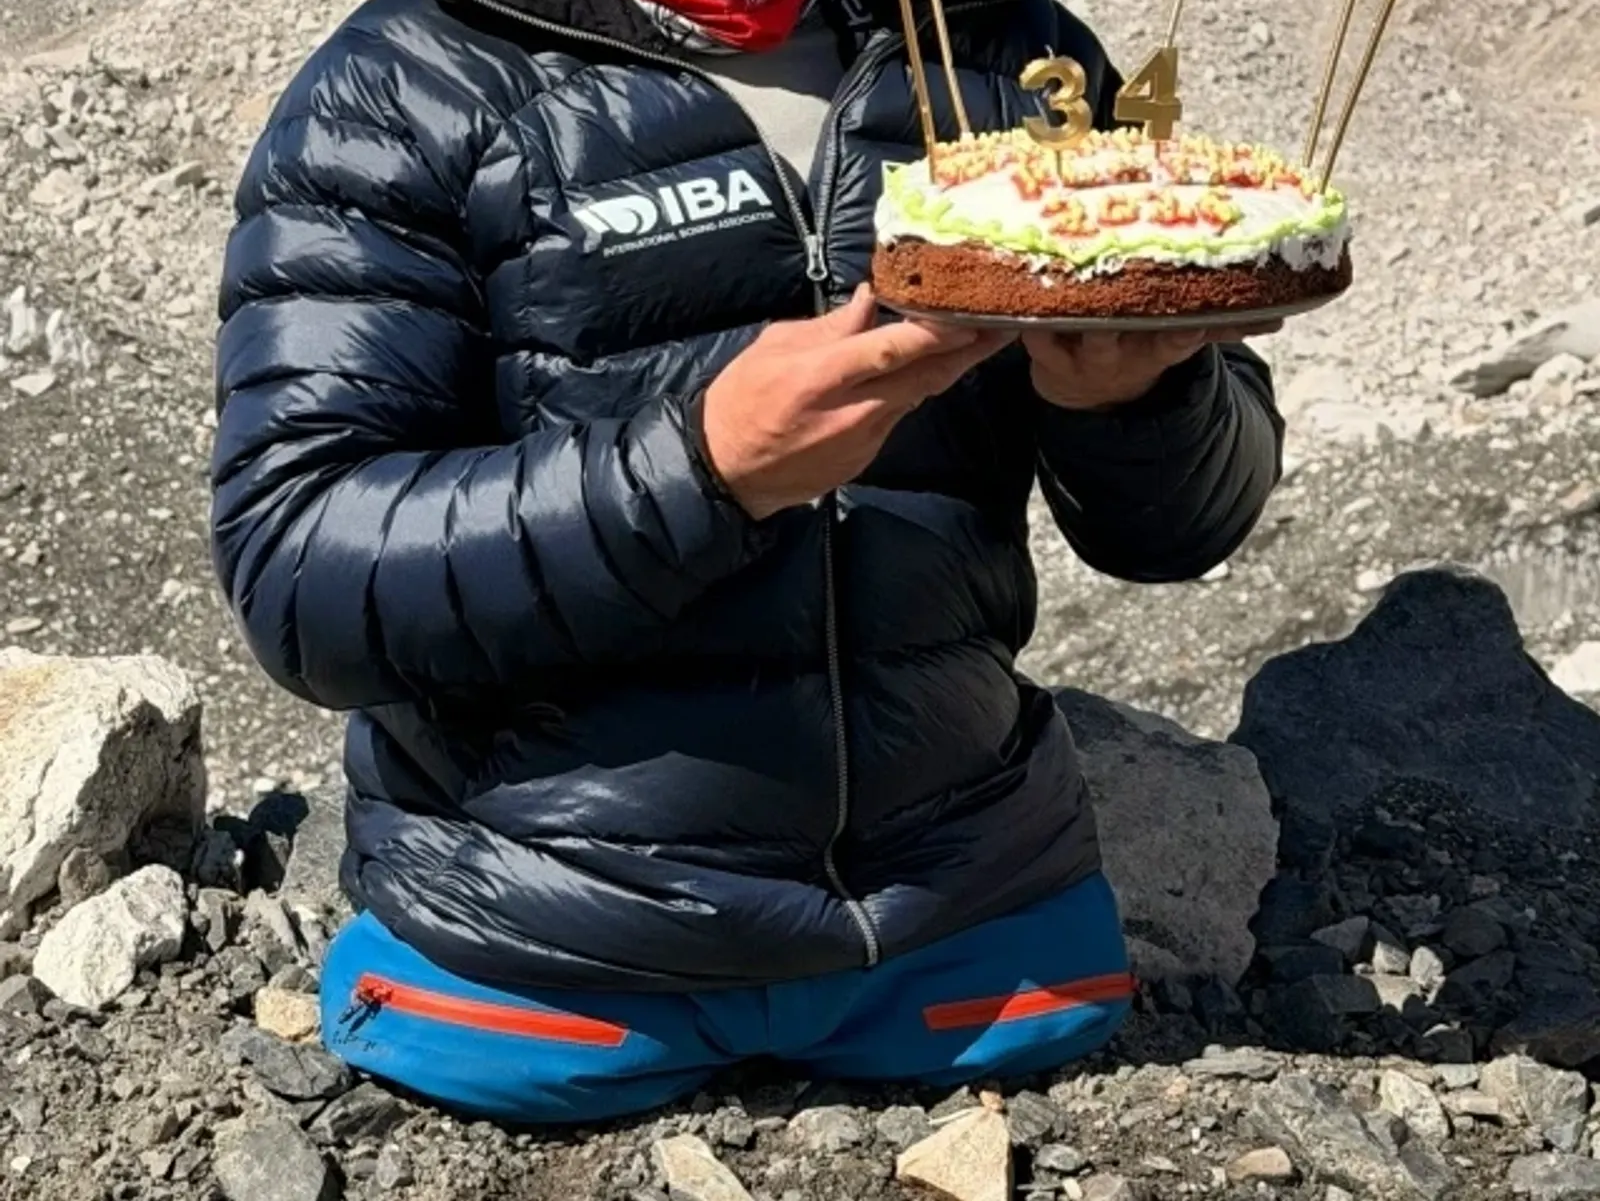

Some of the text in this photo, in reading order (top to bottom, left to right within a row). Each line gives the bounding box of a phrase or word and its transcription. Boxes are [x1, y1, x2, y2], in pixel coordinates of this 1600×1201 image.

[1020, 49, 1182, 147] 34
[657, 169, 772, 226] IBA
[603, 211, 776, 257] INTERNATIONAL BOXING ASSOCIATION
